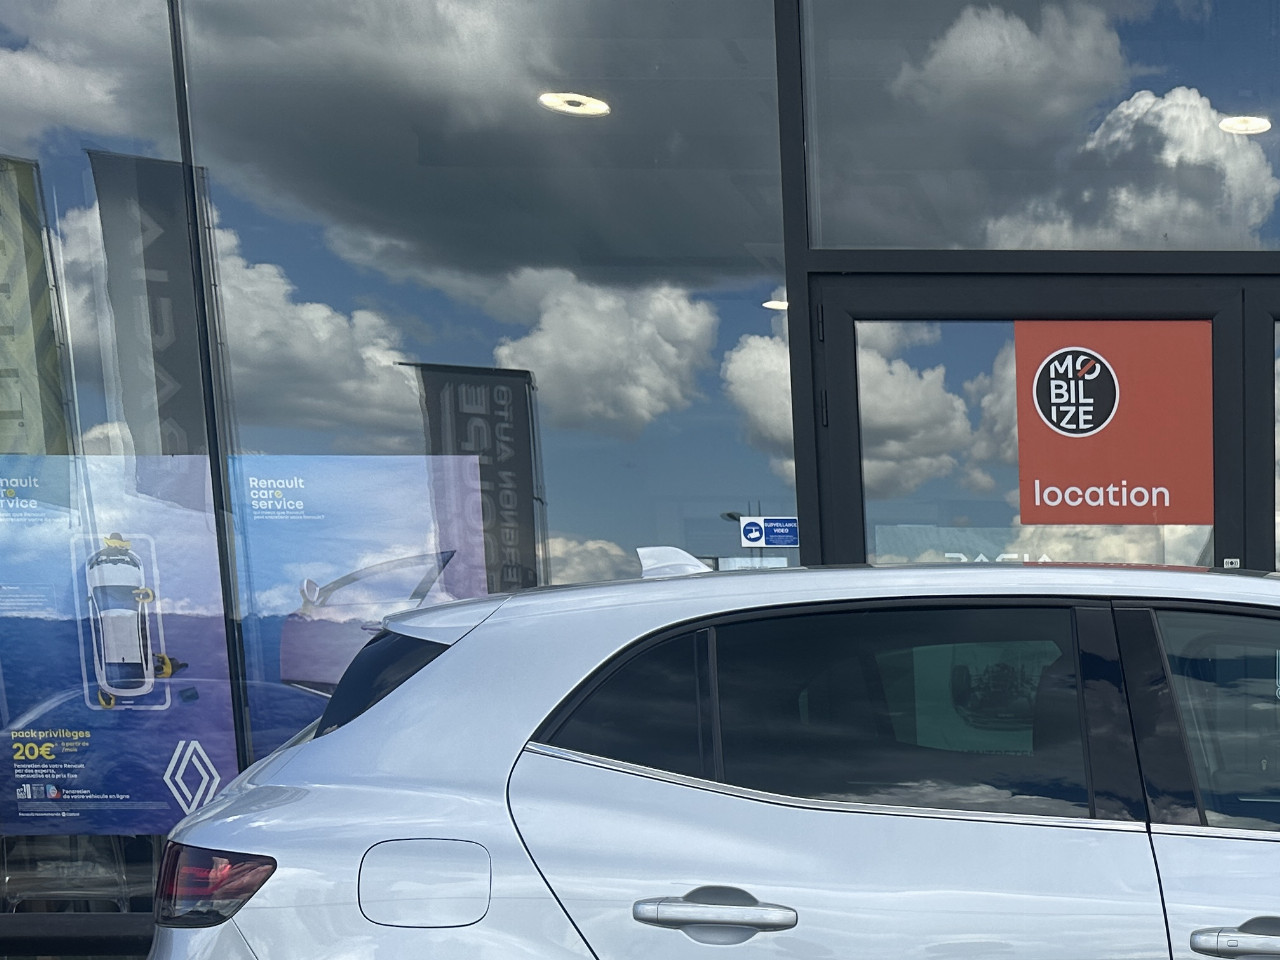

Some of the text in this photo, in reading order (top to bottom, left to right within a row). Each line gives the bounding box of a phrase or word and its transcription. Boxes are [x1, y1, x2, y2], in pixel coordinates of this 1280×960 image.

[248, 476, 305, 489] Renault
[250, 489, 283, 499] care
[1034, 479, 1170, 507] location
[251, 498, 304, 510] service
[11, 729, 92, 740] pack privilèges
